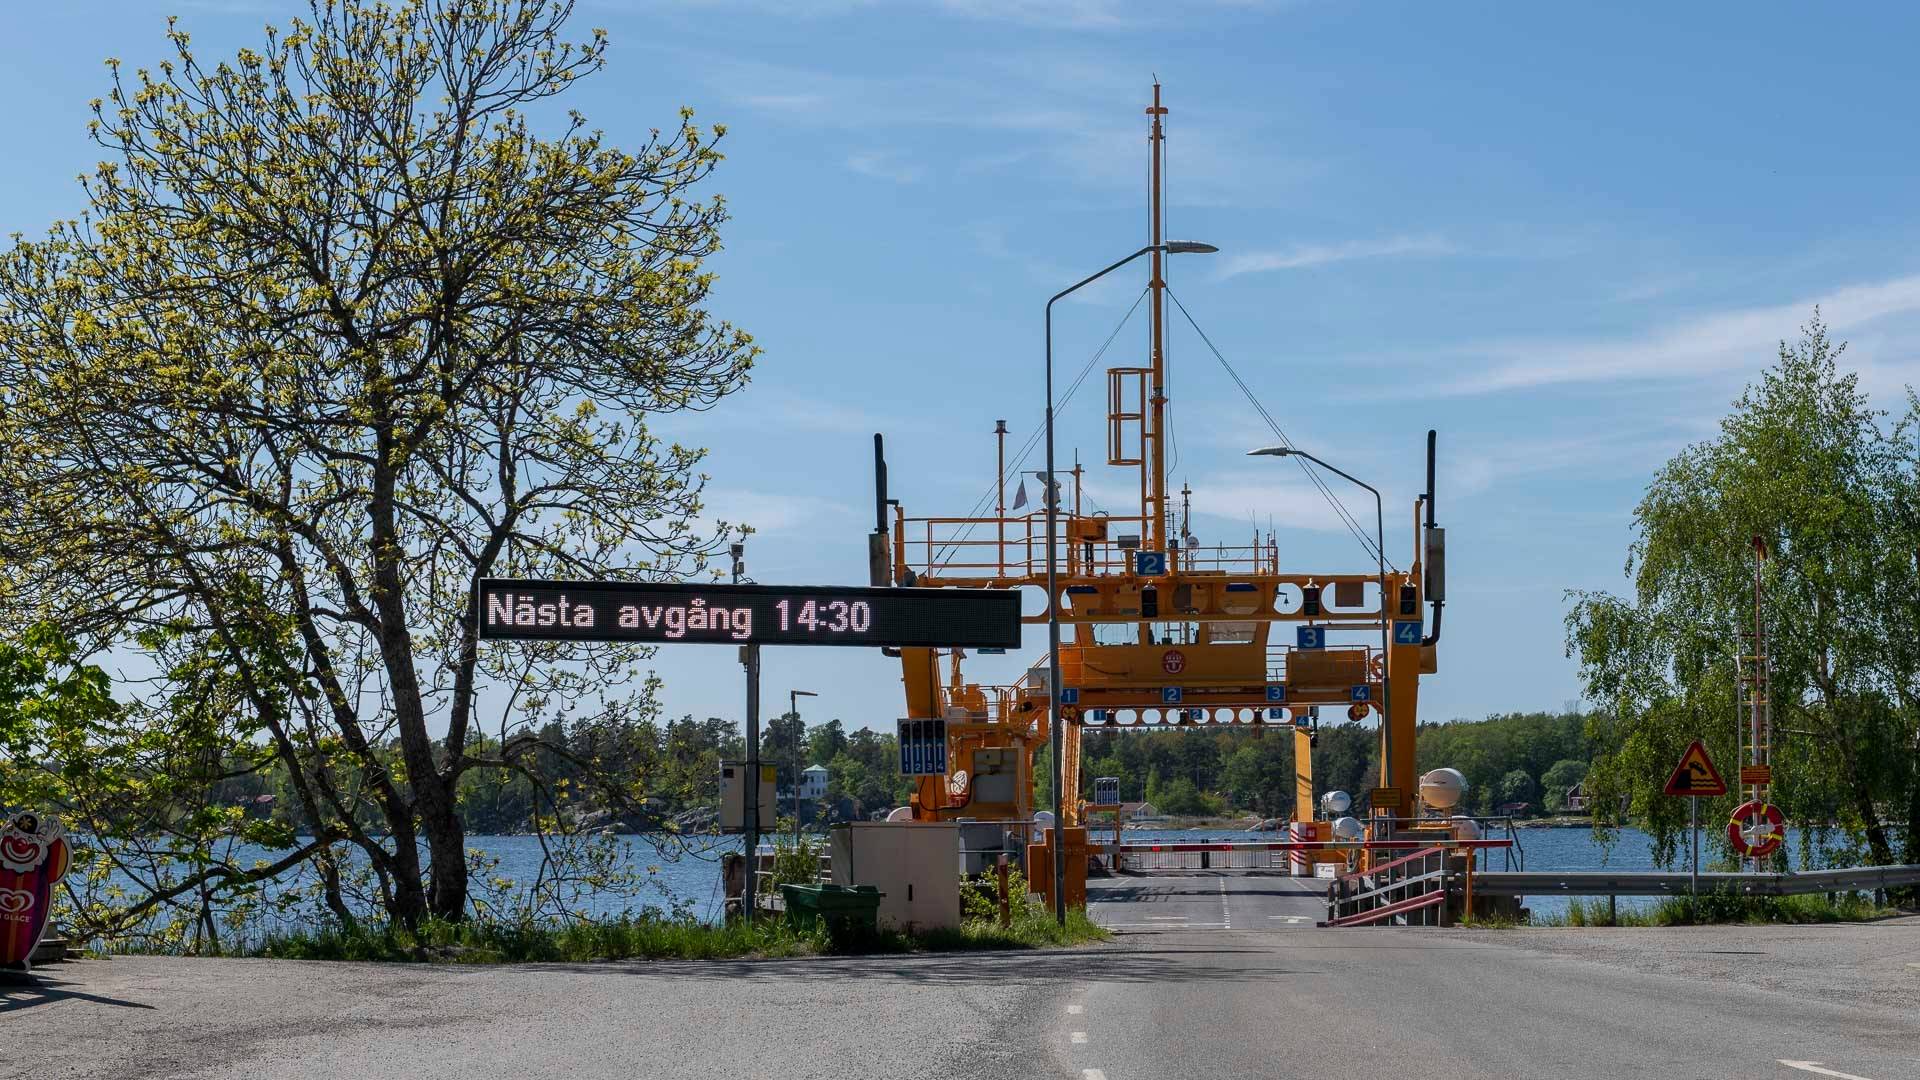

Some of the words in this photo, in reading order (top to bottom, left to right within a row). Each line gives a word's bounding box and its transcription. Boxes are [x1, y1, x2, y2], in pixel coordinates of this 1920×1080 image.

[1144, 555, 1158, 573] 2
[488, 593, 594, 627] Nästa
[618, 598, 752, 639] avgång
[775, 599, 870, 632] 14:30
[1303, 629, 1317, 648] 3
[1400, 624, 1415, 642] 4
[1066, 689, 1071, 701] 1
[1167, 688, 1177, 700] 2
[1271, 688, 1280, 700] 3
[1355, 687, 1366, 699] 4
[1192, 710, 1199, 719] 2
[1272, 708, 1279, 718] 3
[914, 763, 921, 771] 2
[926, 763, 932, 771] 3
[4, 913, 30, 922] GLACE
